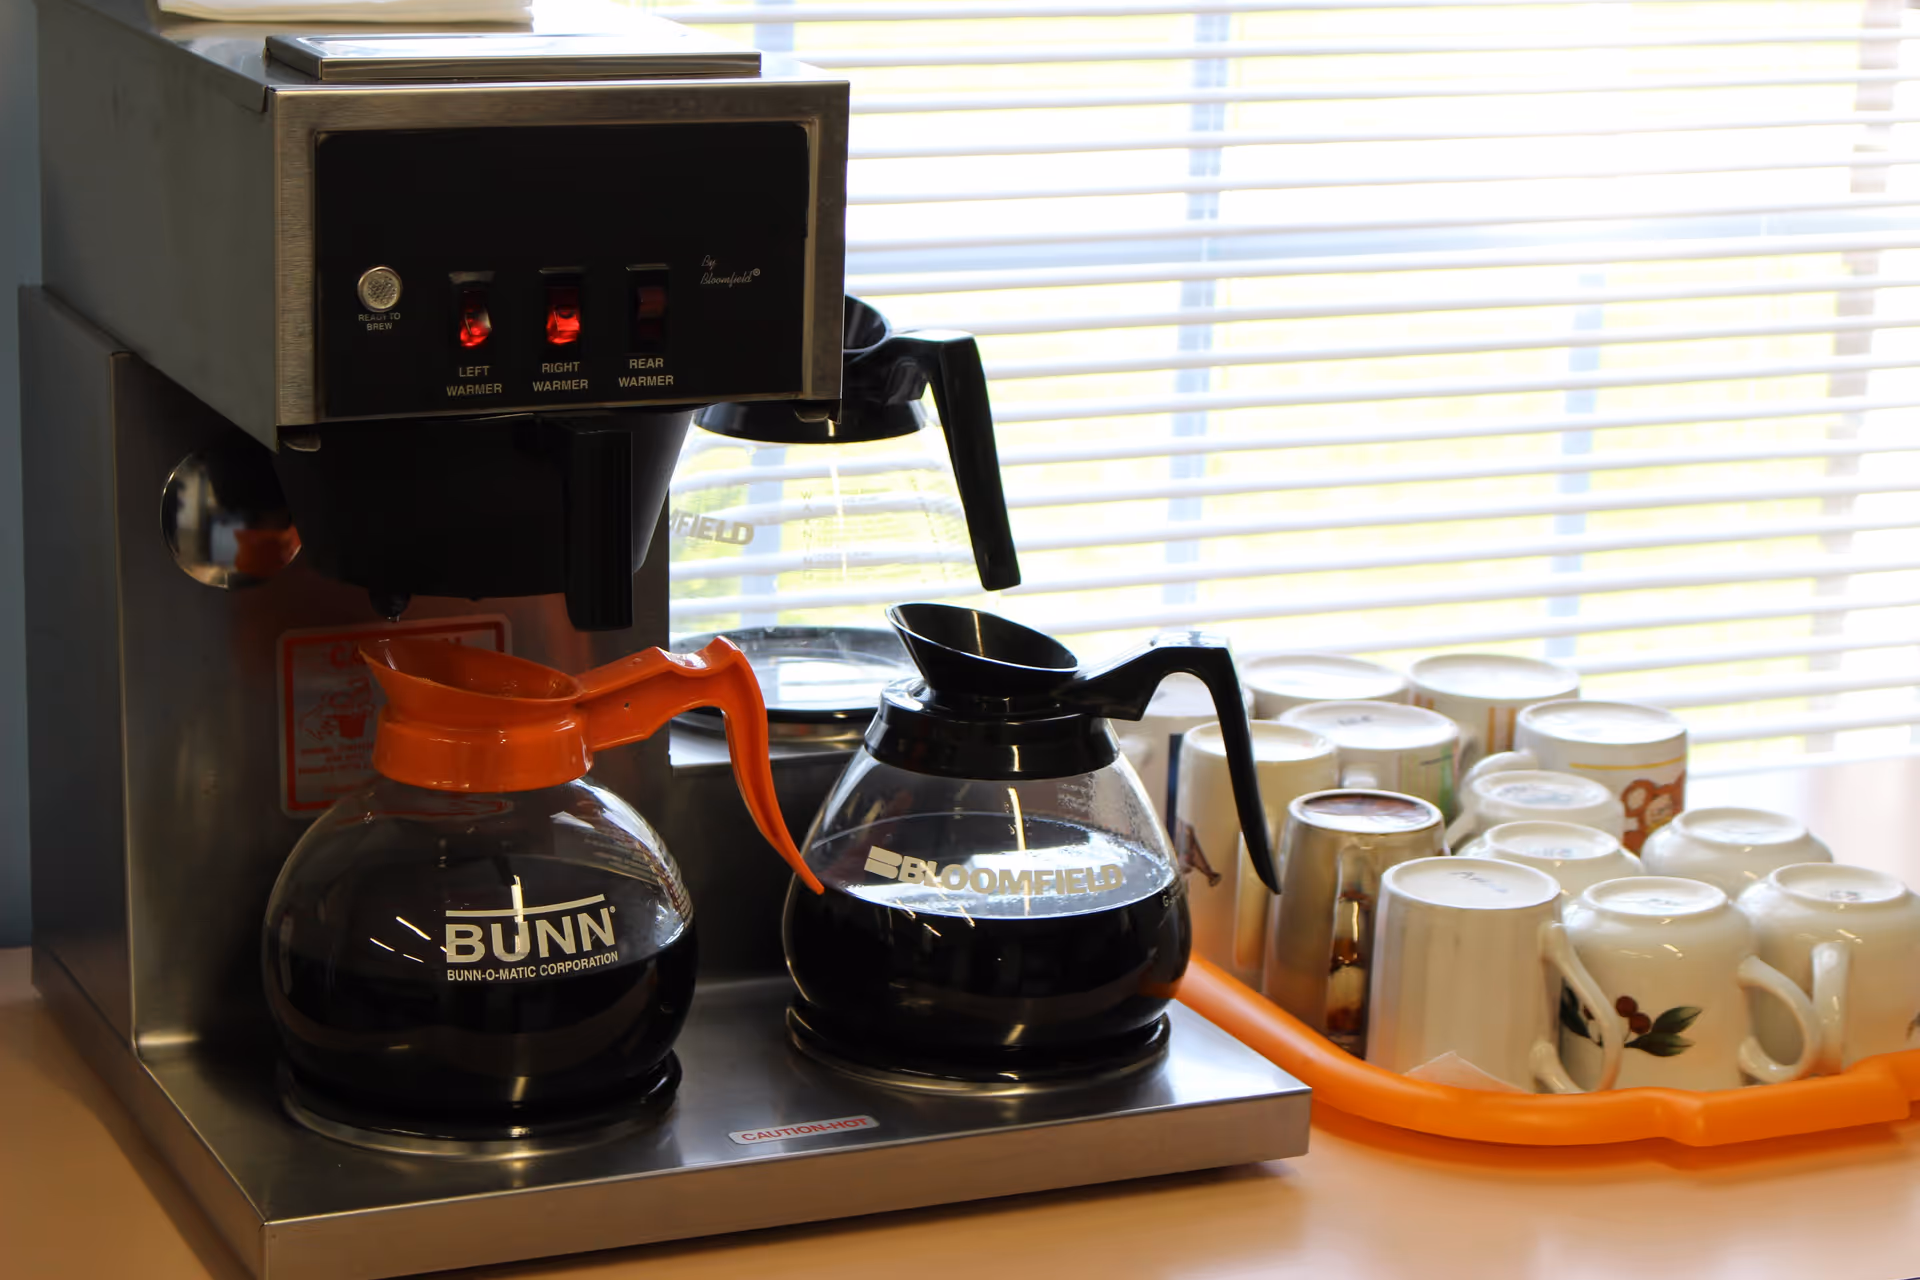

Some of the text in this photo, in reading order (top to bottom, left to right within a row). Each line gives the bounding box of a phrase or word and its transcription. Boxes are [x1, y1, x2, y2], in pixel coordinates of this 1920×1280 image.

[358, 312, 401, 322] READY TO
[366, 322, 393, 331] BREW
[541, 361, 581, 374] RIGHT
[629, 357, 664, 369] REAR
[458, 365, 490, 377] LEFT
[532, 379, 589, 392] WARMER
[618, 374, 674, 388] WARMER
[446, 383, 503, 397] WARMER
[898, 855, 1124, 896] BLOOMFIELD
[447, 951, 619, 981] BUNN-O-MATIC CORPORATION
[741, 1117, 868, 1142] CAUTION-HOT
